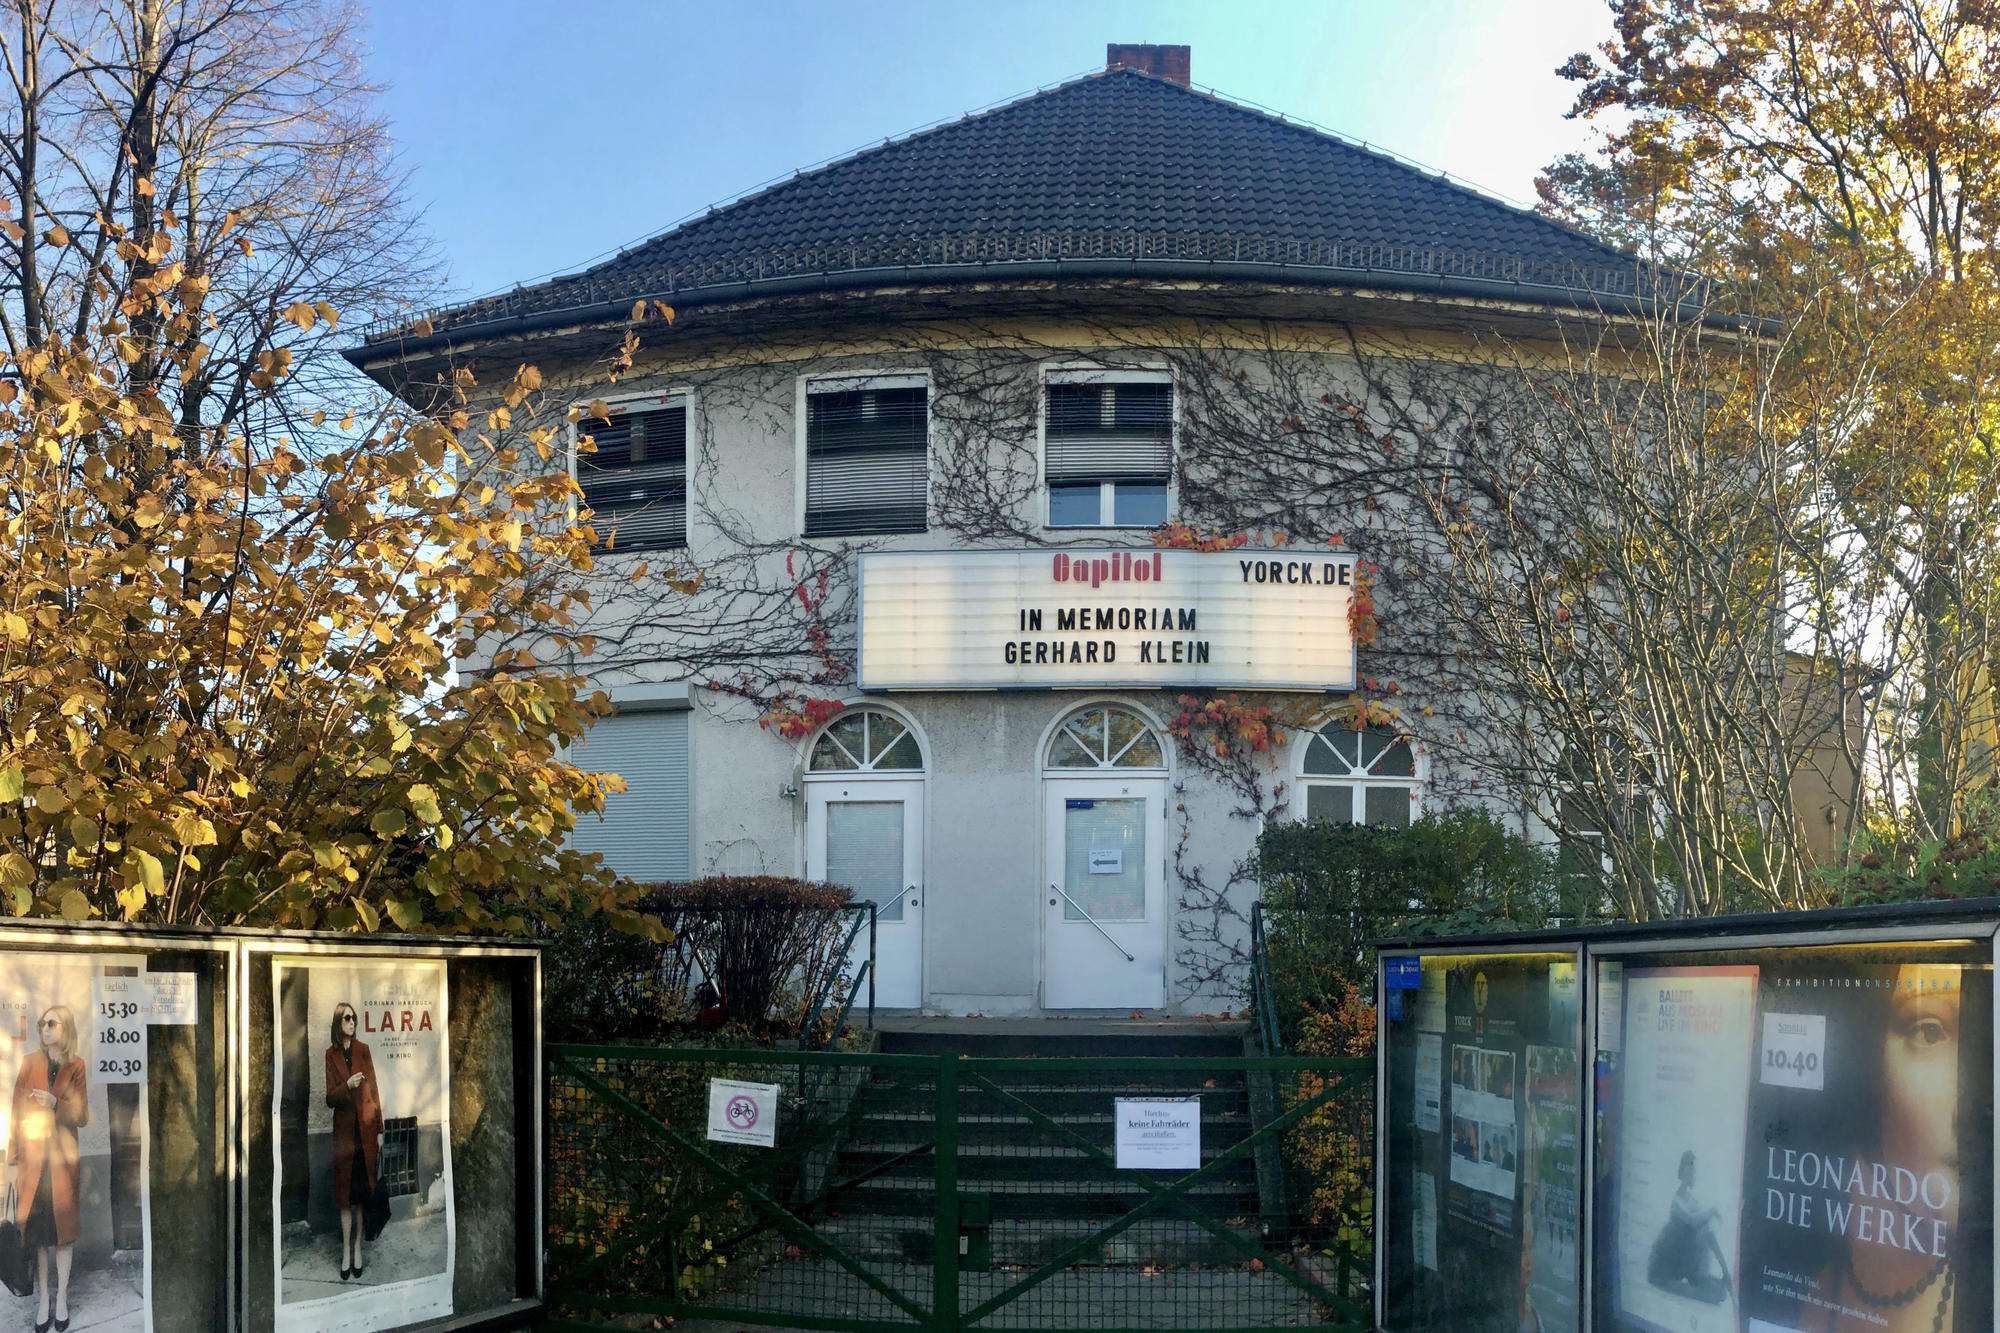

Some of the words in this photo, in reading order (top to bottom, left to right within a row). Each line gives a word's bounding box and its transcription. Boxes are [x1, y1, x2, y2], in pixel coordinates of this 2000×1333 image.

[1053, 552, 1162, 588] Capitol
[1240, 560, 1351, 586] YORCK.DE
[1020, 608, 1042, 632] IN
[1058, 607, 1197, 632] MEMORIAM
[1004, 640, 1116, 665] GERHARD
[1141, 640, 1210, 665] KLEIN
[1659, 989, 1694, 1003] BALLETT
[100, 1002, 138, 1019] 15.30
[364, 1010, 433, 1033] LARA
[100, 1027, 140, 1044] 18.00
[99, 1059, 142, 1076] 20.30
[1766, 1049, 1818, 1077] 10.40
[1128, 1119, 1150, 1128] keine
[1151, 1119, 1191, 1128] Fahrräder
[1767, 1146, 1951, 1210] LEONARDO
[1765, 1188, 1812, 1229] DIE
[1825, 1198, 1948, 1258] WERKE
[1763, 1265, 1794, 1281] Leonardo
[1794, 1273, 1803, 1284] da
[1775, 1284, 1785, 1296] Sie
